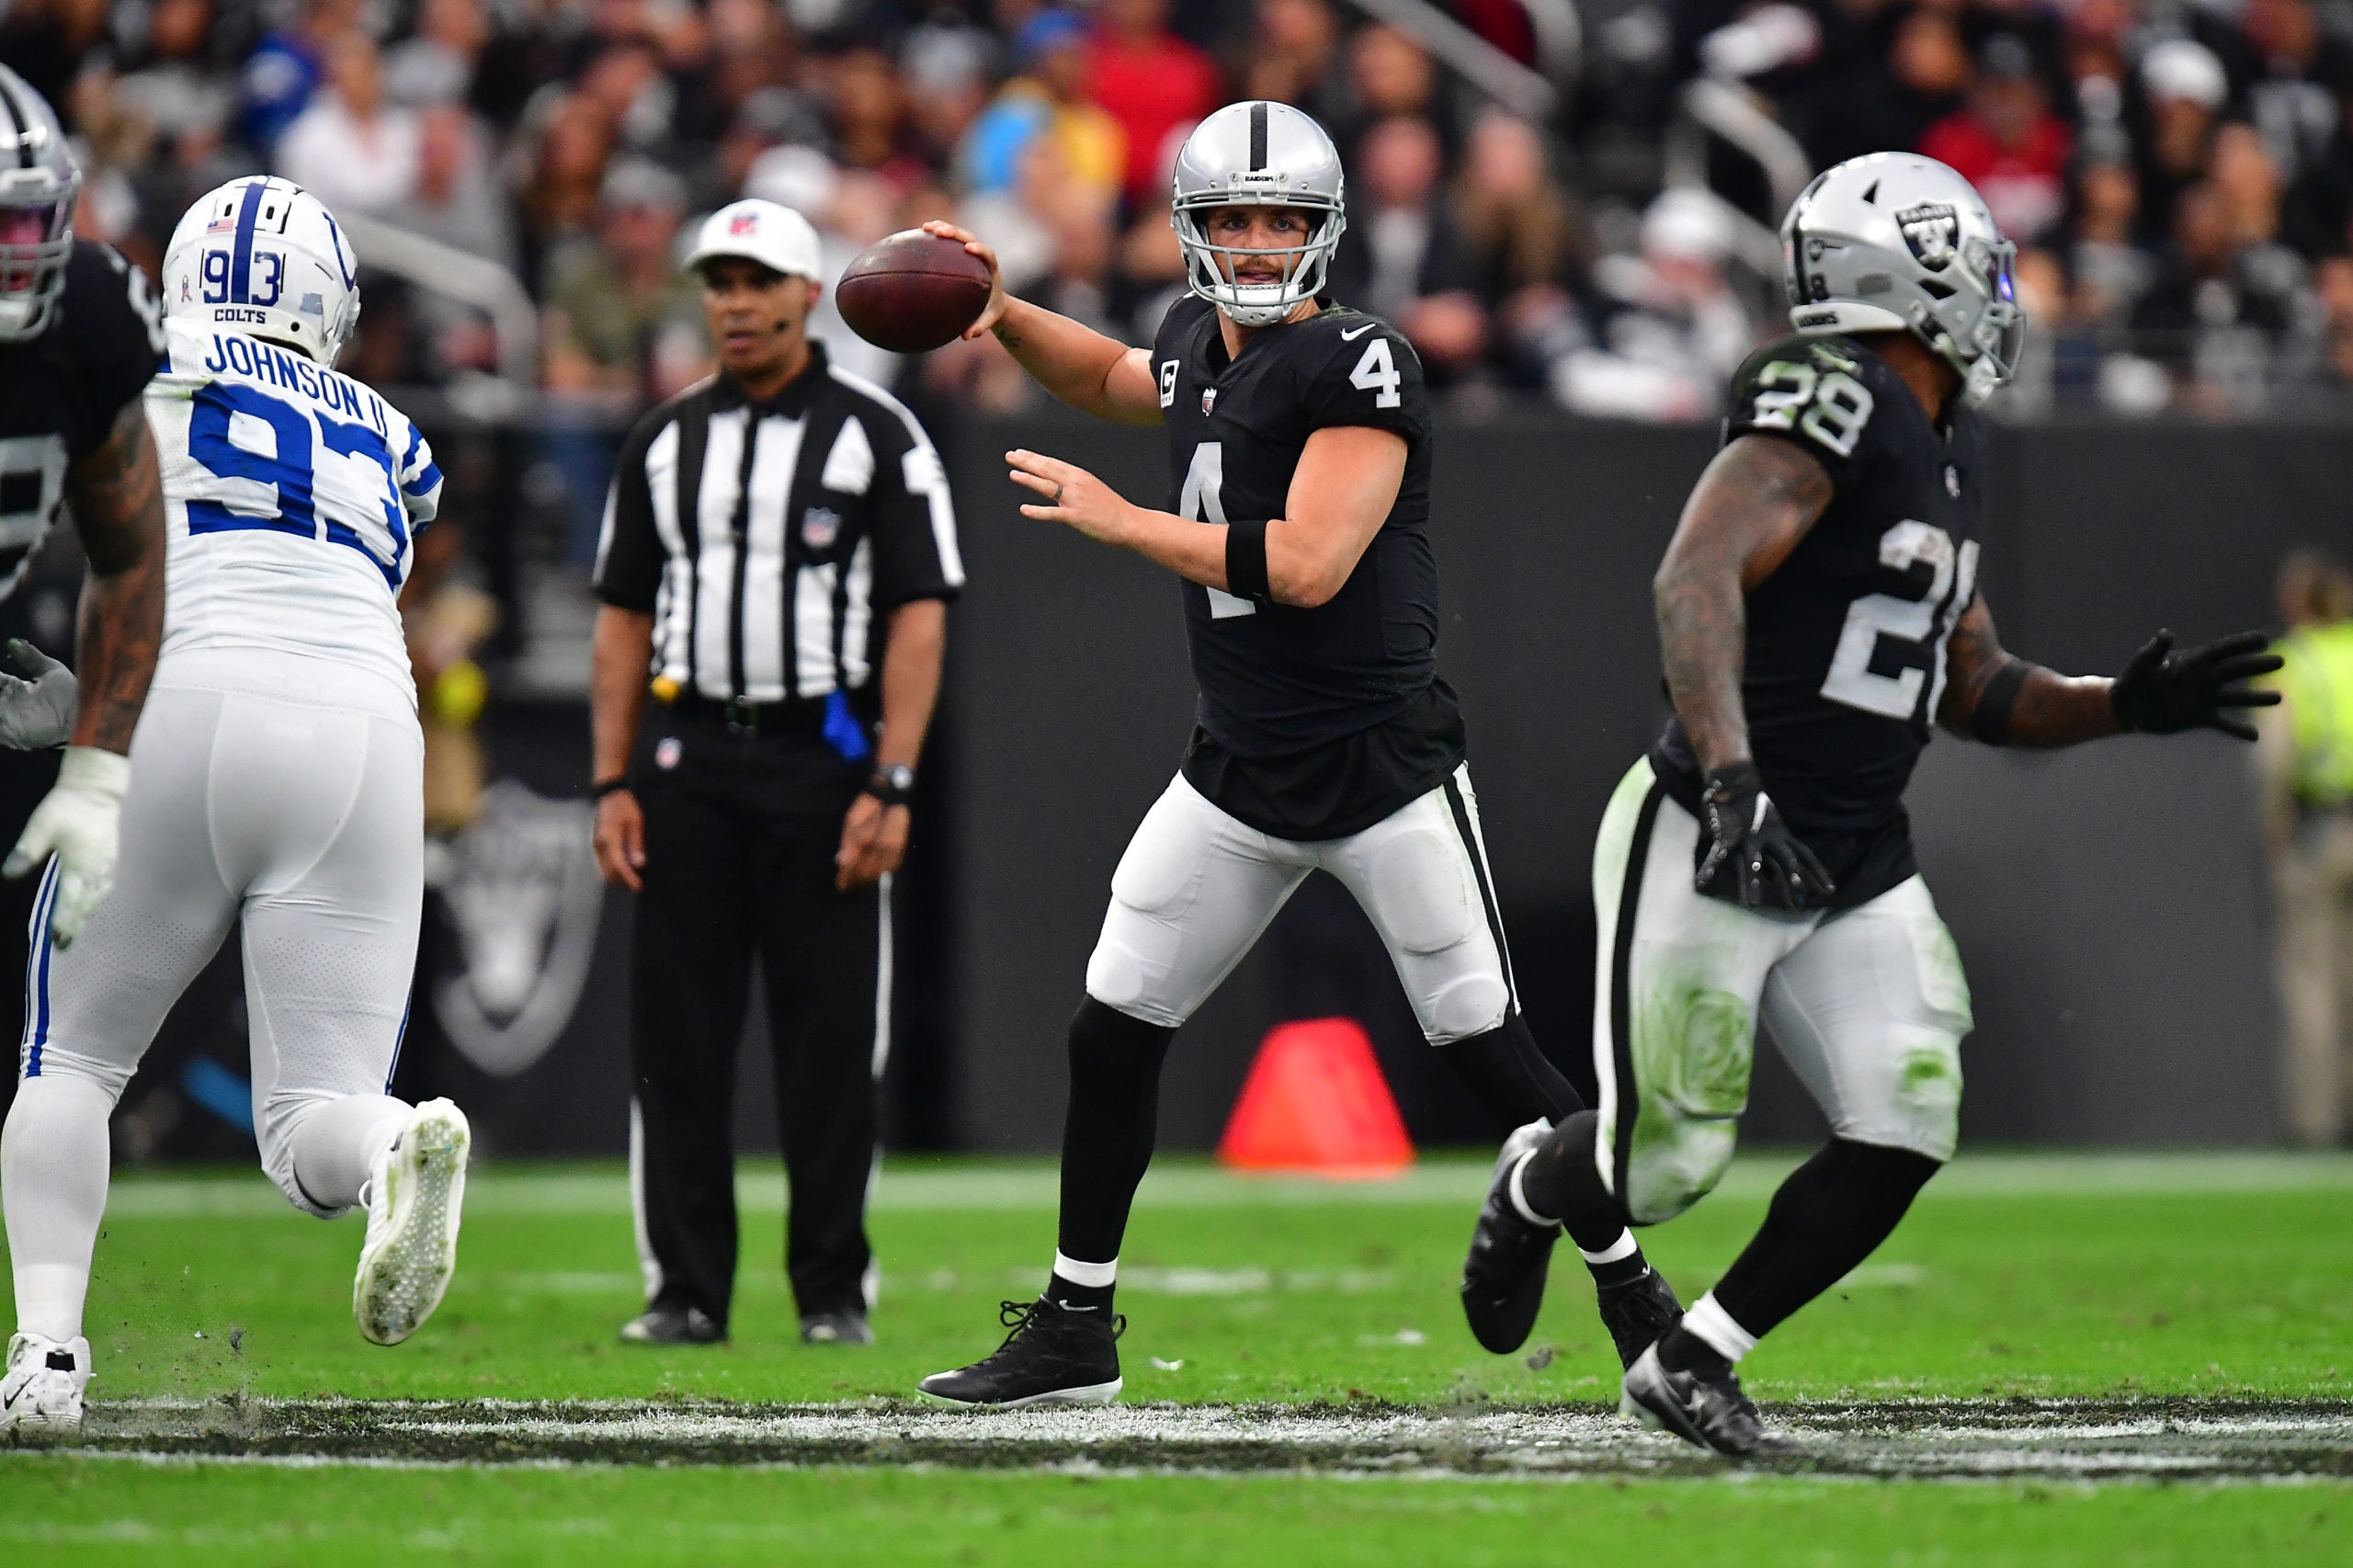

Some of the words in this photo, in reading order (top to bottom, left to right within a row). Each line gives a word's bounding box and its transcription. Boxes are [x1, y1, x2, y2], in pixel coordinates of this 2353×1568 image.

[203, 249, 281, 307] 93
[214, 308, 266, 324] COLTS
[205, 334, 365, 421] JOHNSON
[1162, 364, 1175, 395] C
[1348, 338, 1401, 409] 4
[1753, 359, 1874, 458] 28
[186, 380, 407, 594] 93
